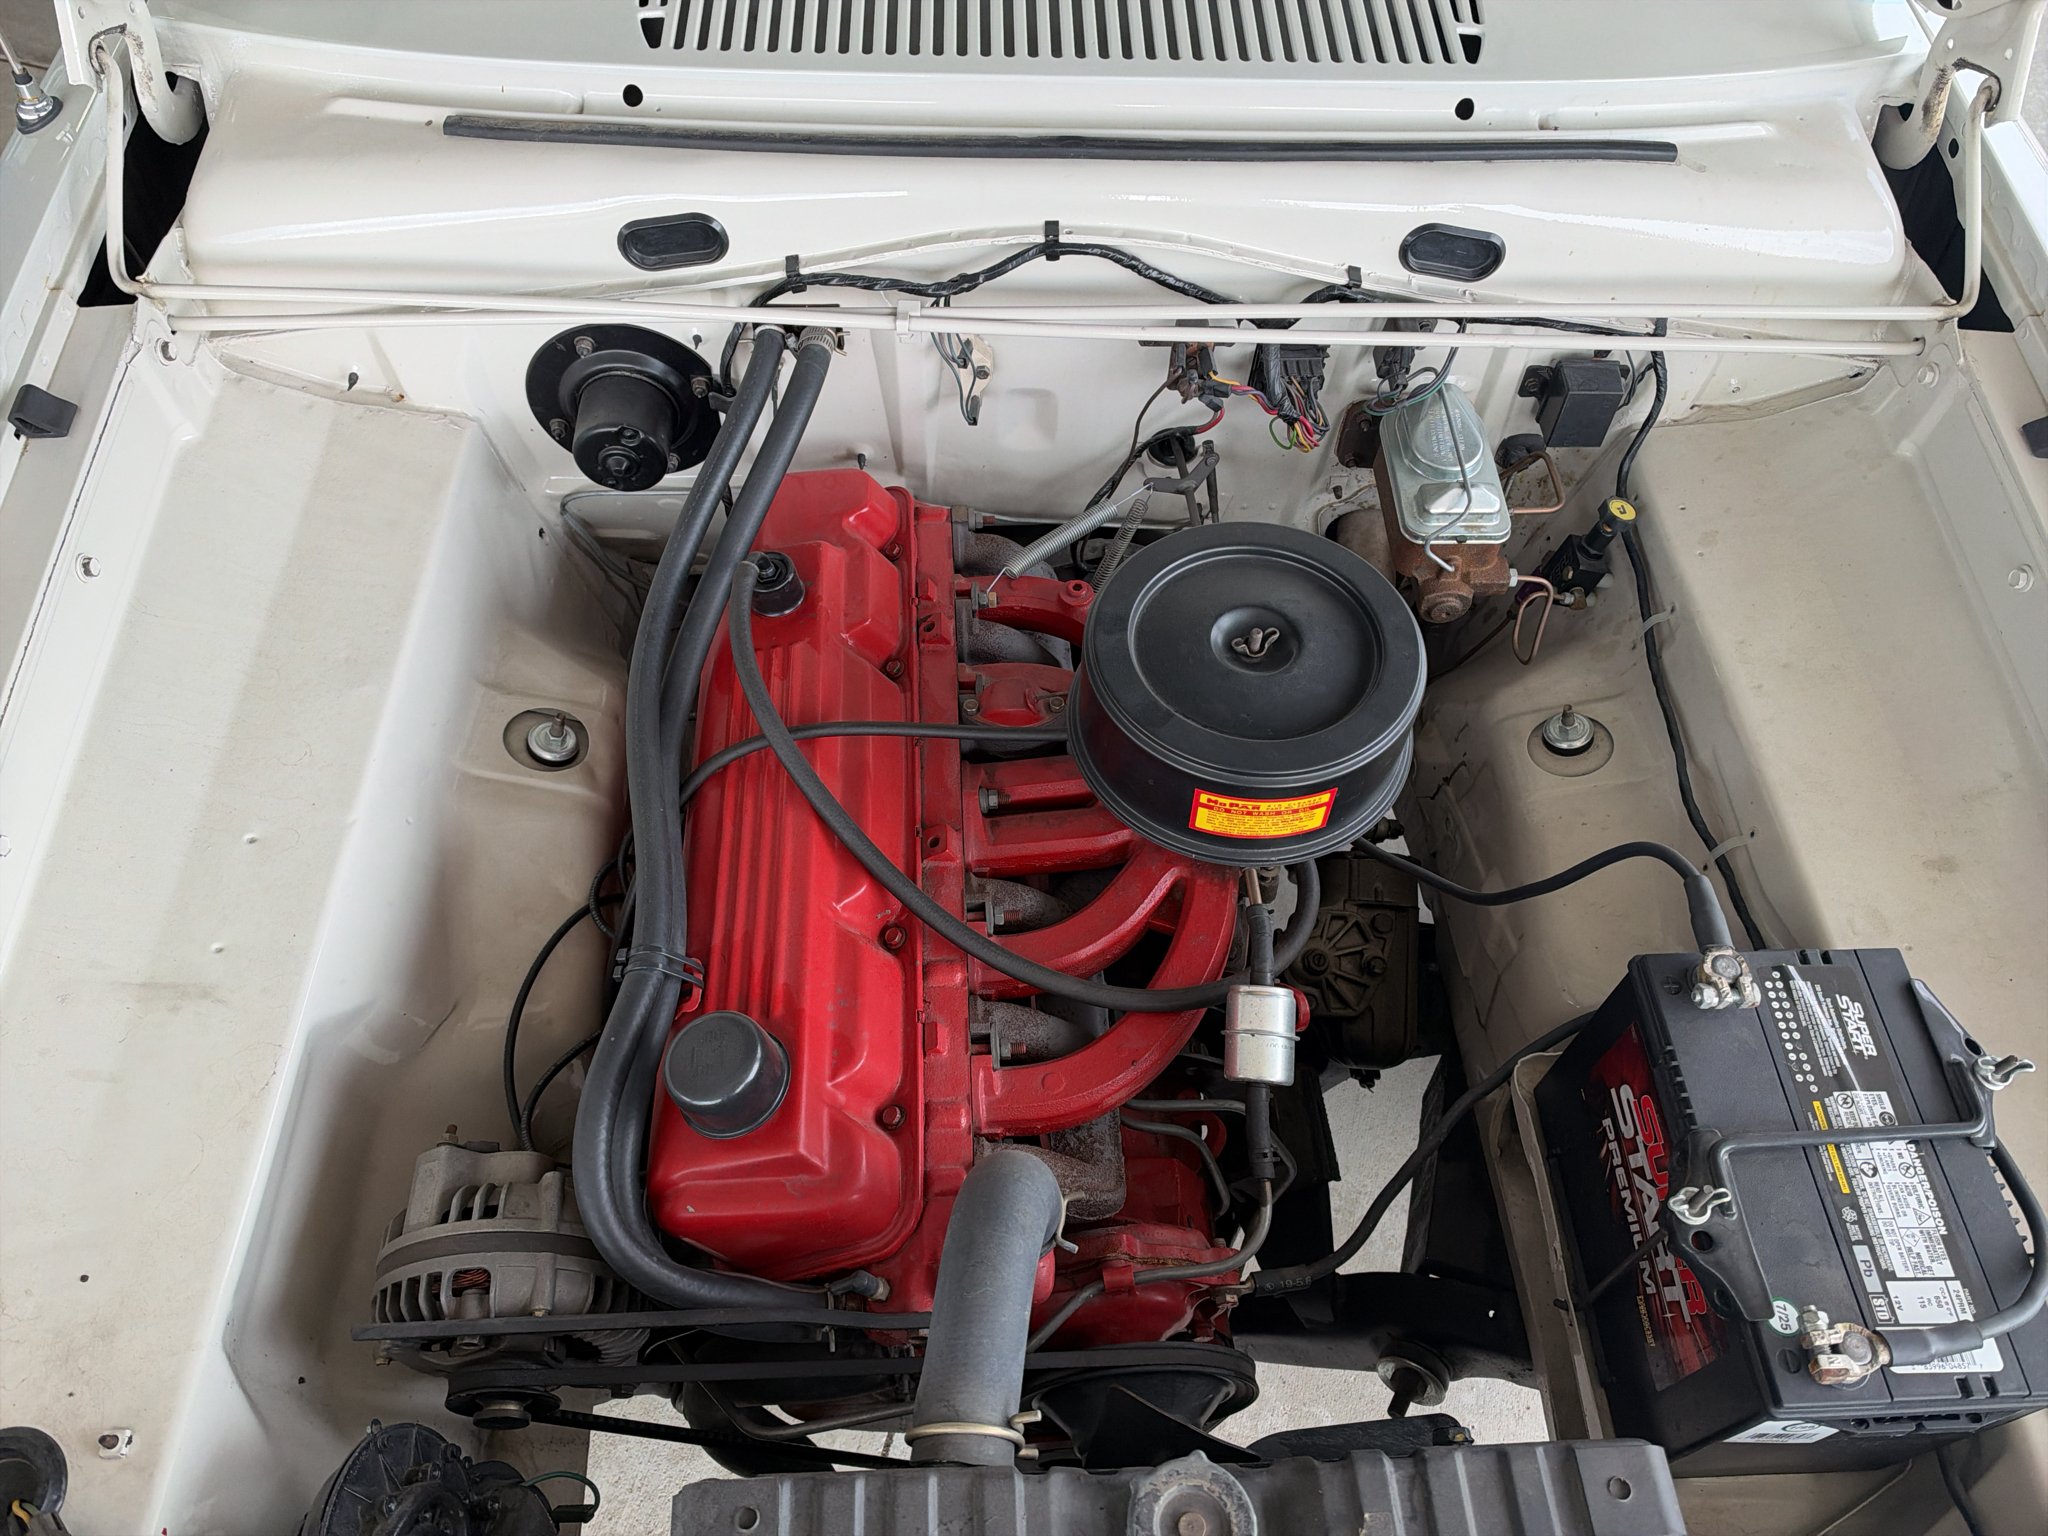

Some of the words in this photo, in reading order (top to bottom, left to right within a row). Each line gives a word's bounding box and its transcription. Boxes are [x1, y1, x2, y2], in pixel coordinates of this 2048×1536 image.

[1836, 994, 1870, 1056] START
[1849, 1002, 1880, 1056] SUPER
[1863, 1094, 1876, 1119] EXPLOSIVE
[1876, 1094, 1886, 1109] SHIELD
[1874, 1182, 1882, 1193] READ
[1886, 1185, 1895, 1201] SEVERE
[1892, 1185, 1904, 1209] BLINDNESS
[1904, 1185, 1913, 1196] ACID
[1907, 1144, 1948, 1235] DANGER/POISON
[1911, 1185, 1925, 1209] SULFURIC
[1632, 1095, 1706, 1315] SUR
[1902, 1195, 1910, 1209] CAUSE
[1894, 1239, 1902, 1250] OPEN
[1907, 1247, 1916, 1259] HELP
[1919, 1230, 1928, 1243] WITH
[1924, 1245, 1936, 1264] WATER.
[1926, 1230, 1943, 1265] IMMEDIATELY
[1932, 1230, 1942, 1245] FLUSH
[1938, 1247, 1947, 1260] EYES
[1860, 1260, 1876, 1277] Pb
[1915, 1252, 1928, 1275] MEDICAL
[1927, 1266, 1935, 1275] GET
[1893, 1296, 1903, 1311] 12V
[1917, 1297, 1927, 1308] 115
[1934, 1296, 1944, 1309] 650
[1939, 1287, 1948, 1301] CCA
[1954, 1289, 1968, 1314] 24PRM
[1963, 1289, 1973, 1303] PART
[1774, 1303, 1792, 1331] 7/25
[1872, 1298, 1890, 1320] STD
